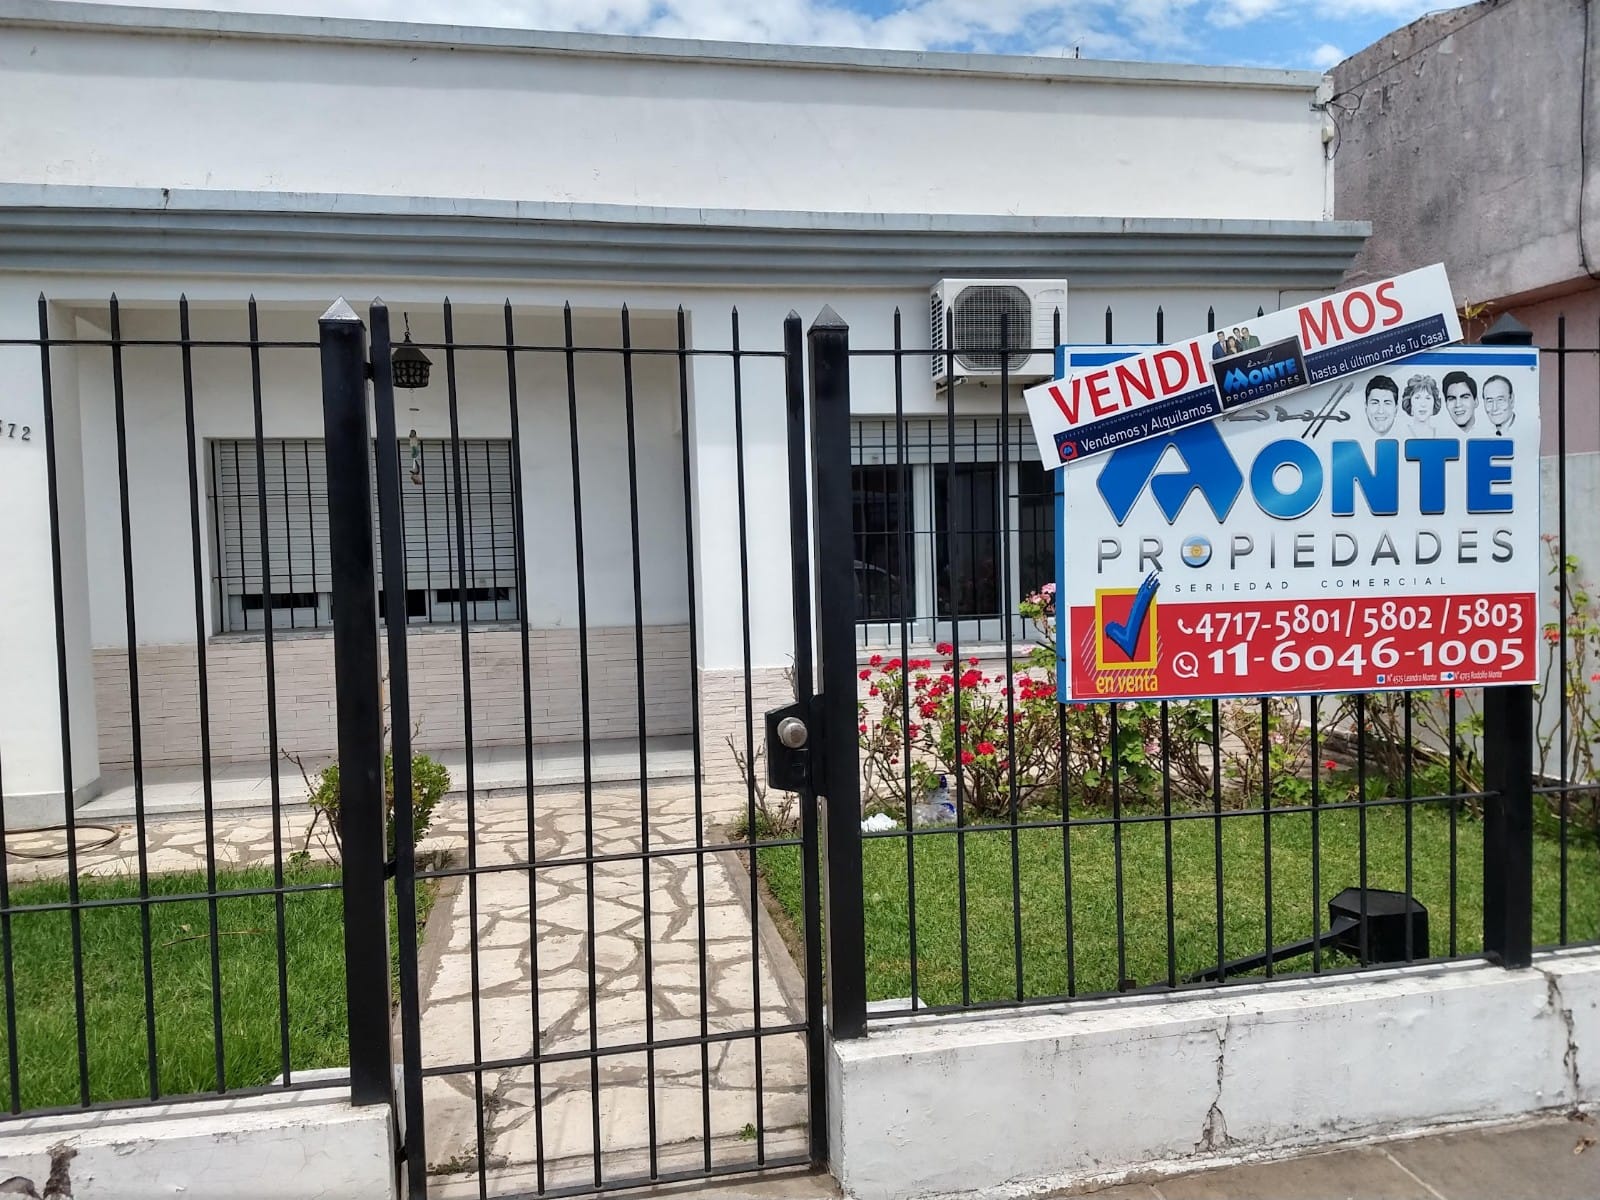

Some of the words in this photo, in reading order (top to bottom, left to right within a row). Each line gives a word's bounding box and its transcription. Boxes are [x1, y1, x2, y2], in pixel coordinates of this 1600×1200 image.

[1298, 281, 1404, 350] MOS
[1310, 363, 1338, 381] hasta
[1339, 360, 1349, 372] el
[1350, 348, 1380, 369] último
[1395, 343, 1407, 355] de
[1407, 338, 1419, 350] Tu
[1420, 329, 1448, 346] Casa!
[1223, 358, 1297, 394] MONTE
[1225, 374, 1301, 402] PROPIEDADES
[0, 419, 31, 441] 72
[1081, 425, 1140, 451] Vendemos
[1141, 424, 1149, 437] y
[1151, 402, 1213, 431] Alquilamos
[1096, 422, 1515, 527] MONTE
[1097, 529, 1514, 574] PROPIEDADES
[1175, 581, 1289, 593] SERIEDAD
[1320, 577, 1446, 588] COMERCIAL
[1208, 637, 1525, 676] 11-6046-1005
[1096, 676, 1115, 694] en
[1118, 671, 1158, 693] venta
